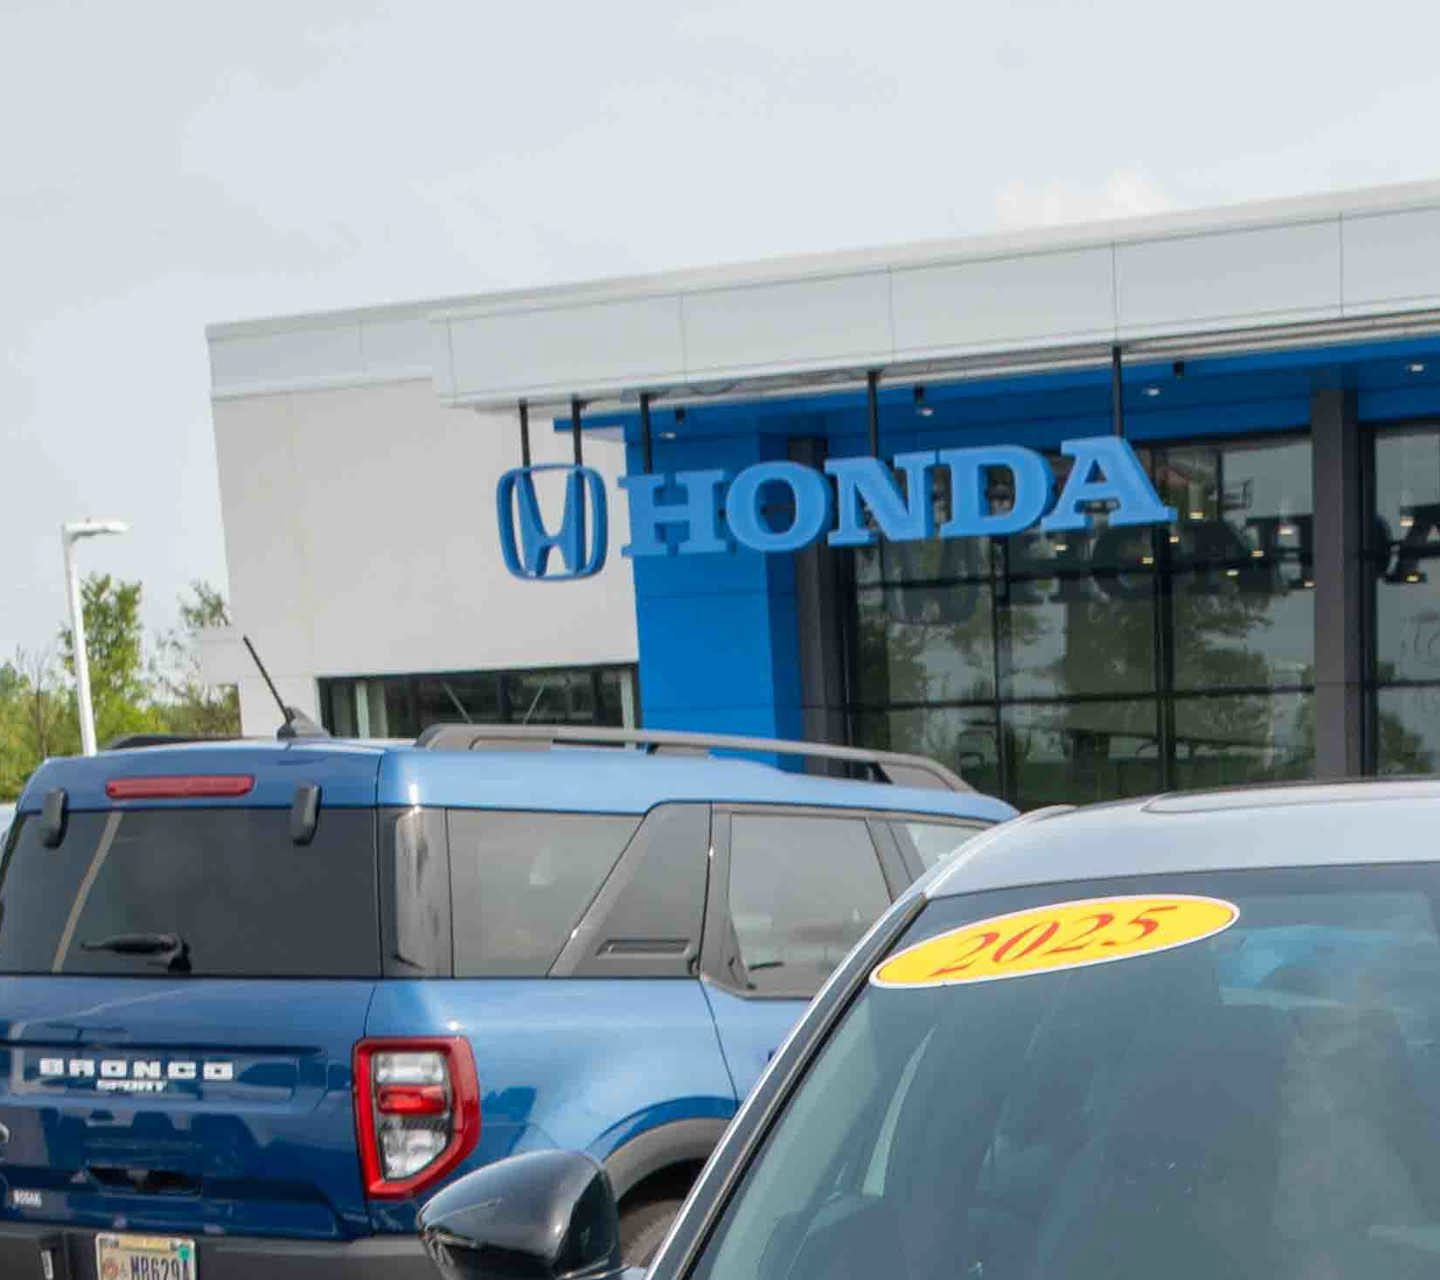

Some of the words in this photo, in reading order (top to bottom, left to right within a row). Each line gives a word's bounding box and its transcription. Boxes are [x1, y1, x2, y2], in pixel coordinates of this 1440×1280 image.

[618, 436, 1177, 558] HONDA
[926, 905, 1178, 977] 2025
[39, 1057, 234, 1081] BRONCO
